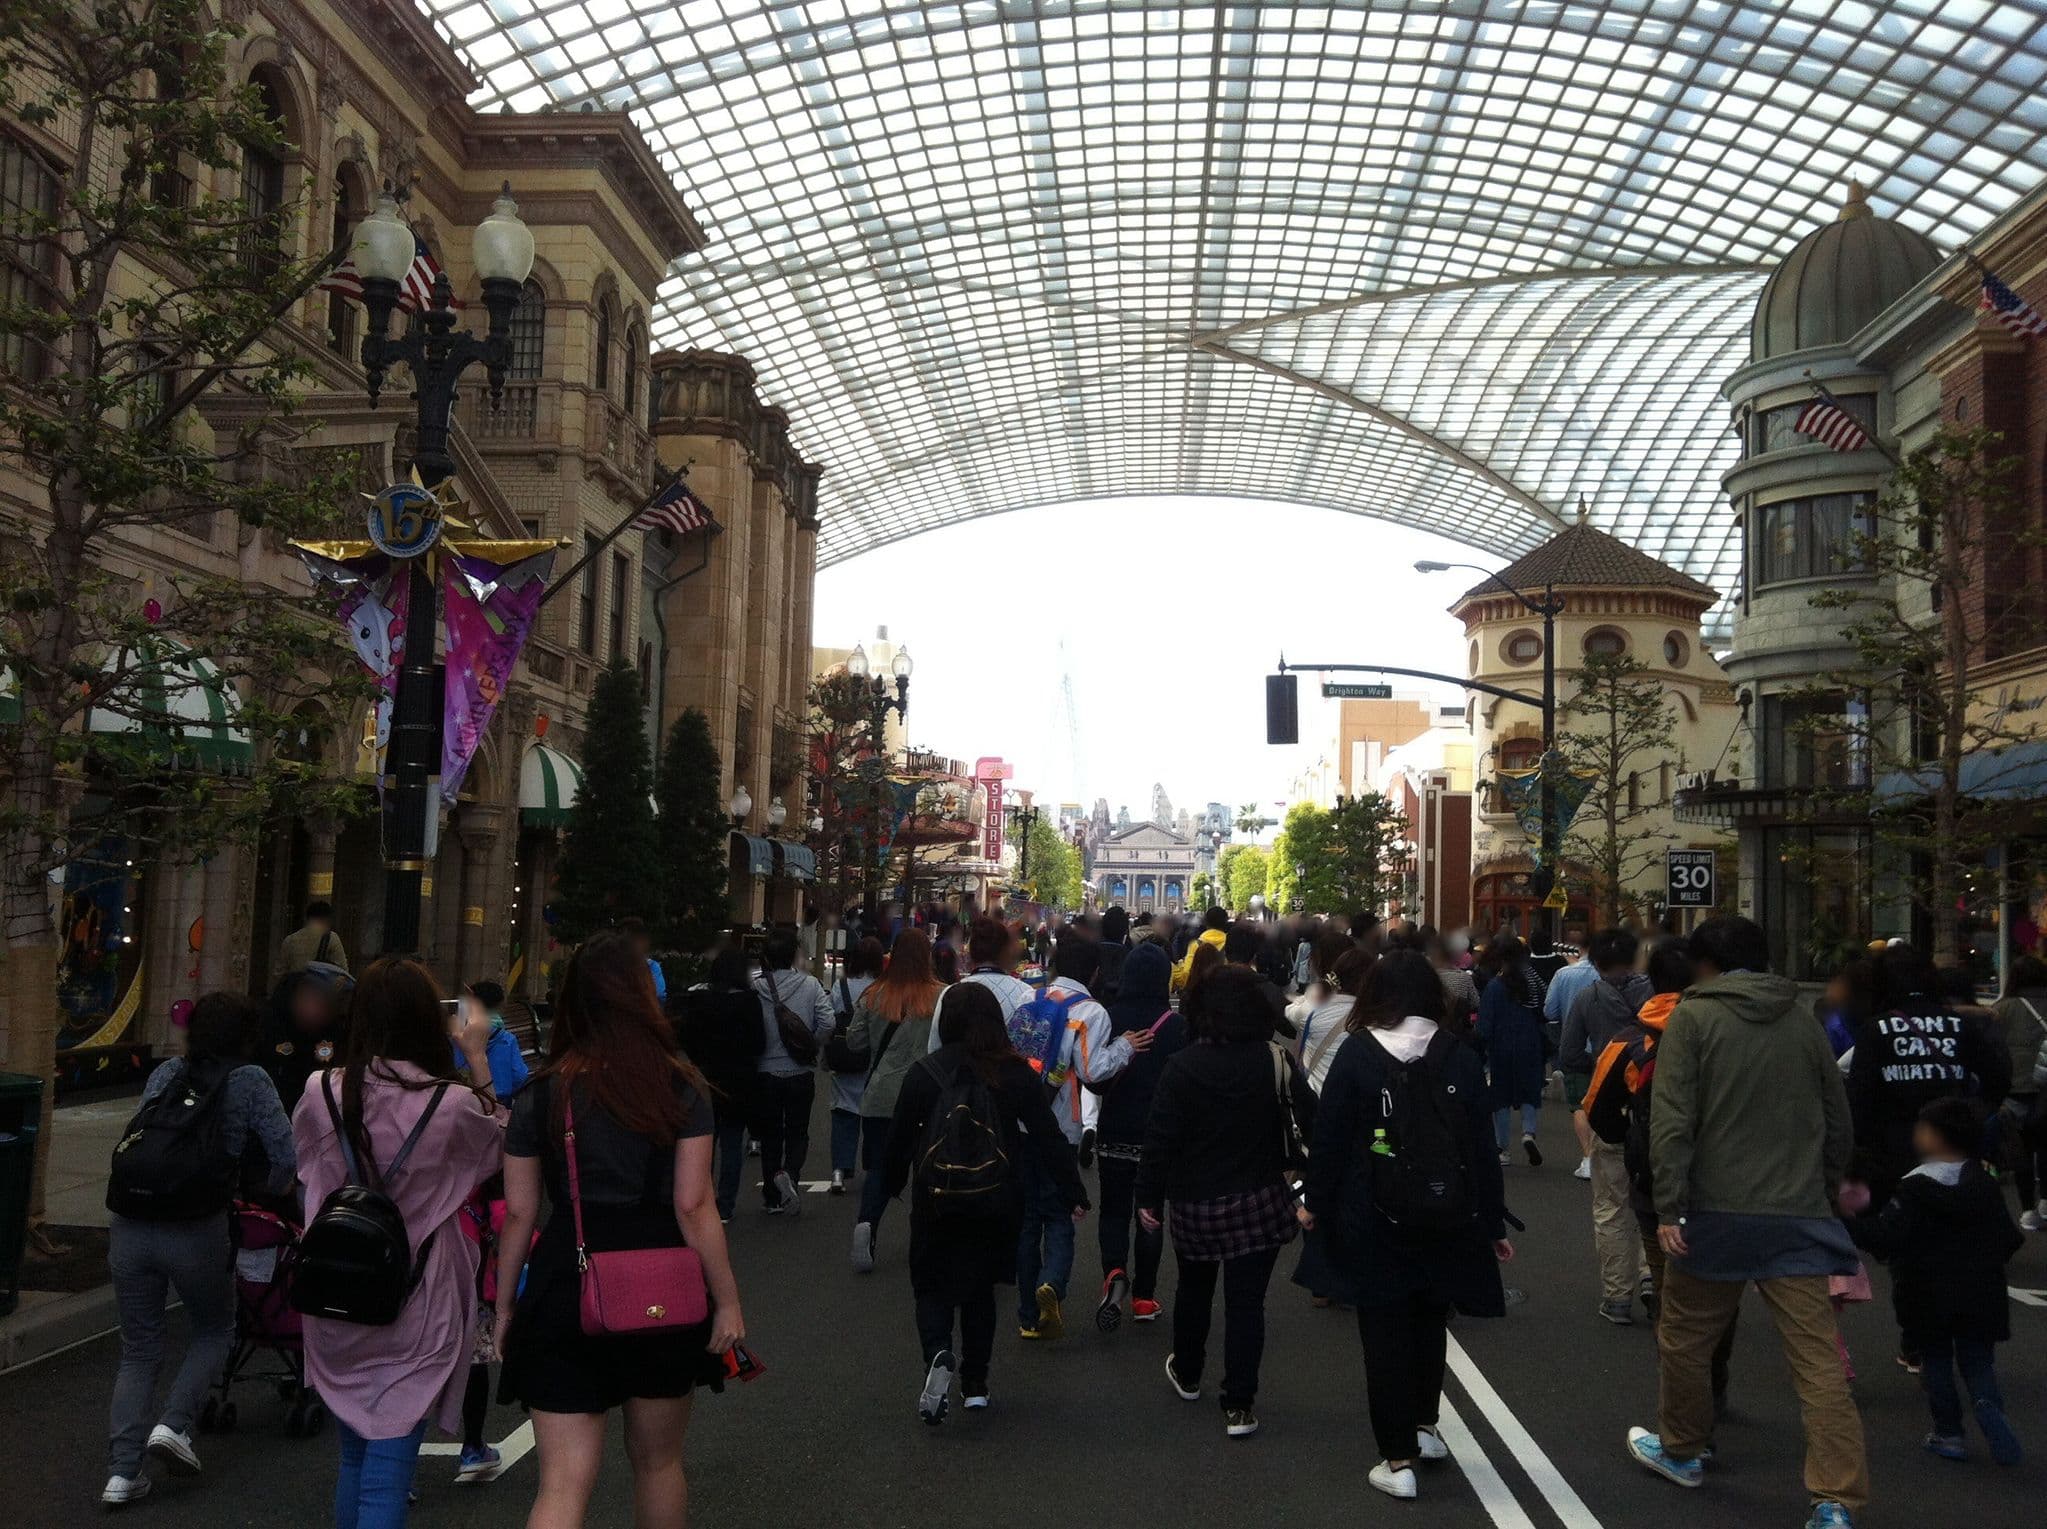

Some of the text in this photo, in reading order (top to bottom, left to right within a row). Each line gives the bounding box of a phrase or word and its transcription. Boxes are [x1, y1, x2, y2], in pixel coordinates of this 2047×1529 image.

[1328, 686, 1386, 696] Brighton Way
[990, 783, 999, 857] STORE
[1670, 854, 1711, 864] SPEED LIMIT
[1671, 865, 1710, 889] 30
[1680, 891, 1701, 901] MILES
